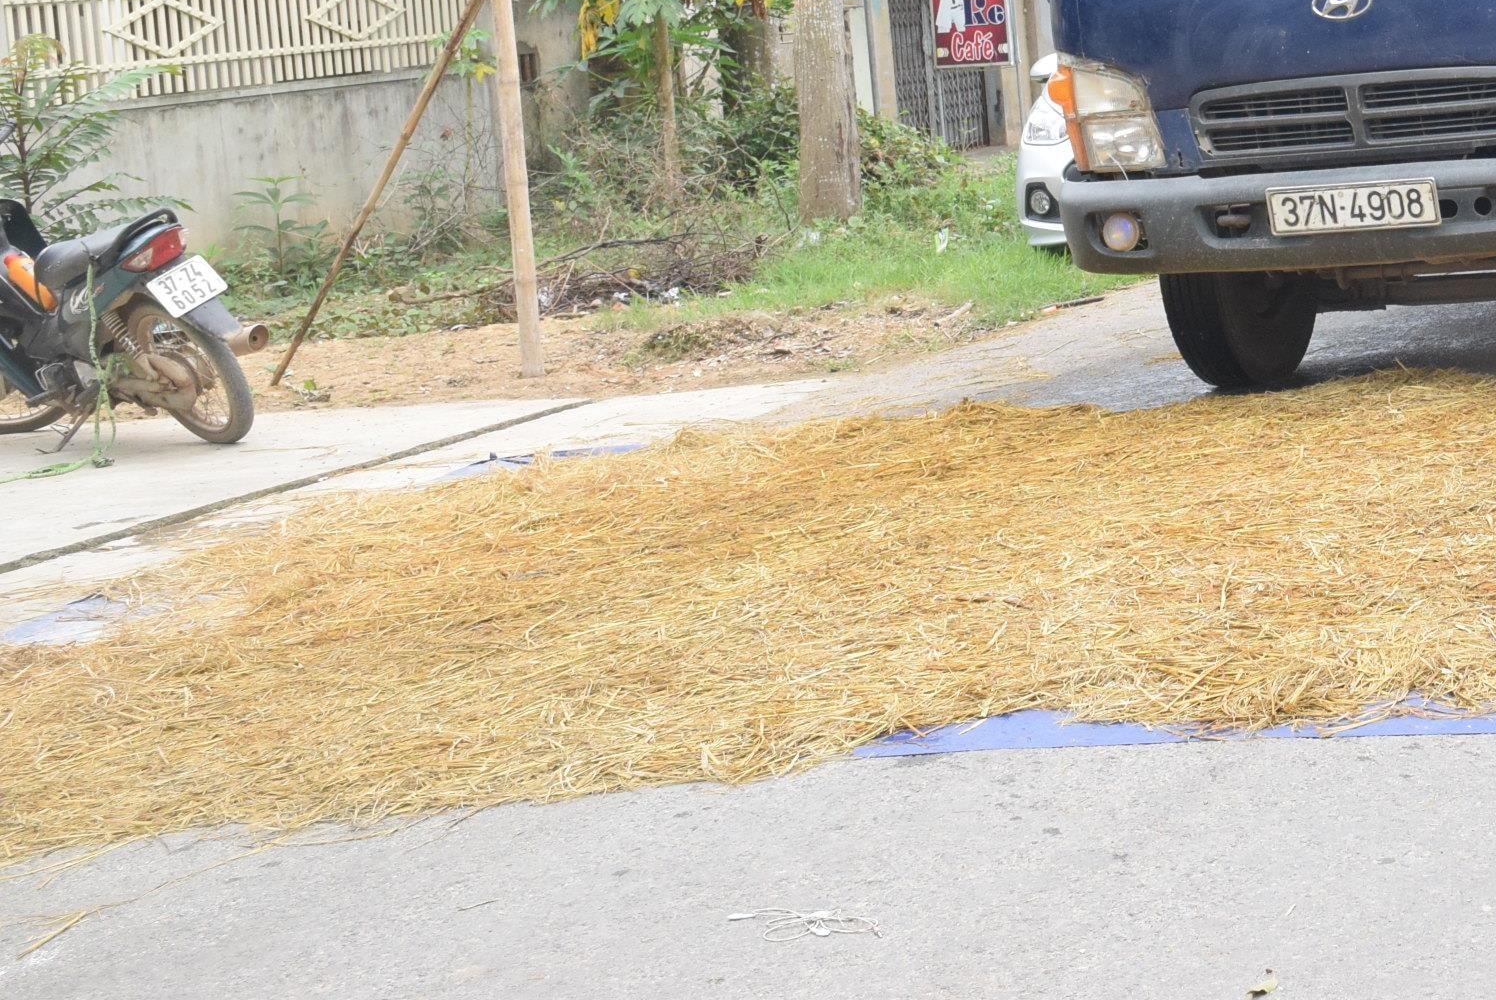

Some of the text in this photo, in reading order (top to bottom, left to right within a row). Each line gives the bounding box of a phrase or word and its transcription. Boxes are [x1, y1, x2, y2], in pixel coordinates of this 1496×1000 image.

[951, 31, 995, 62] Café
[1281, 188, 1424, 227] 37N-4908
[172, 280, 216, 310] 6052
